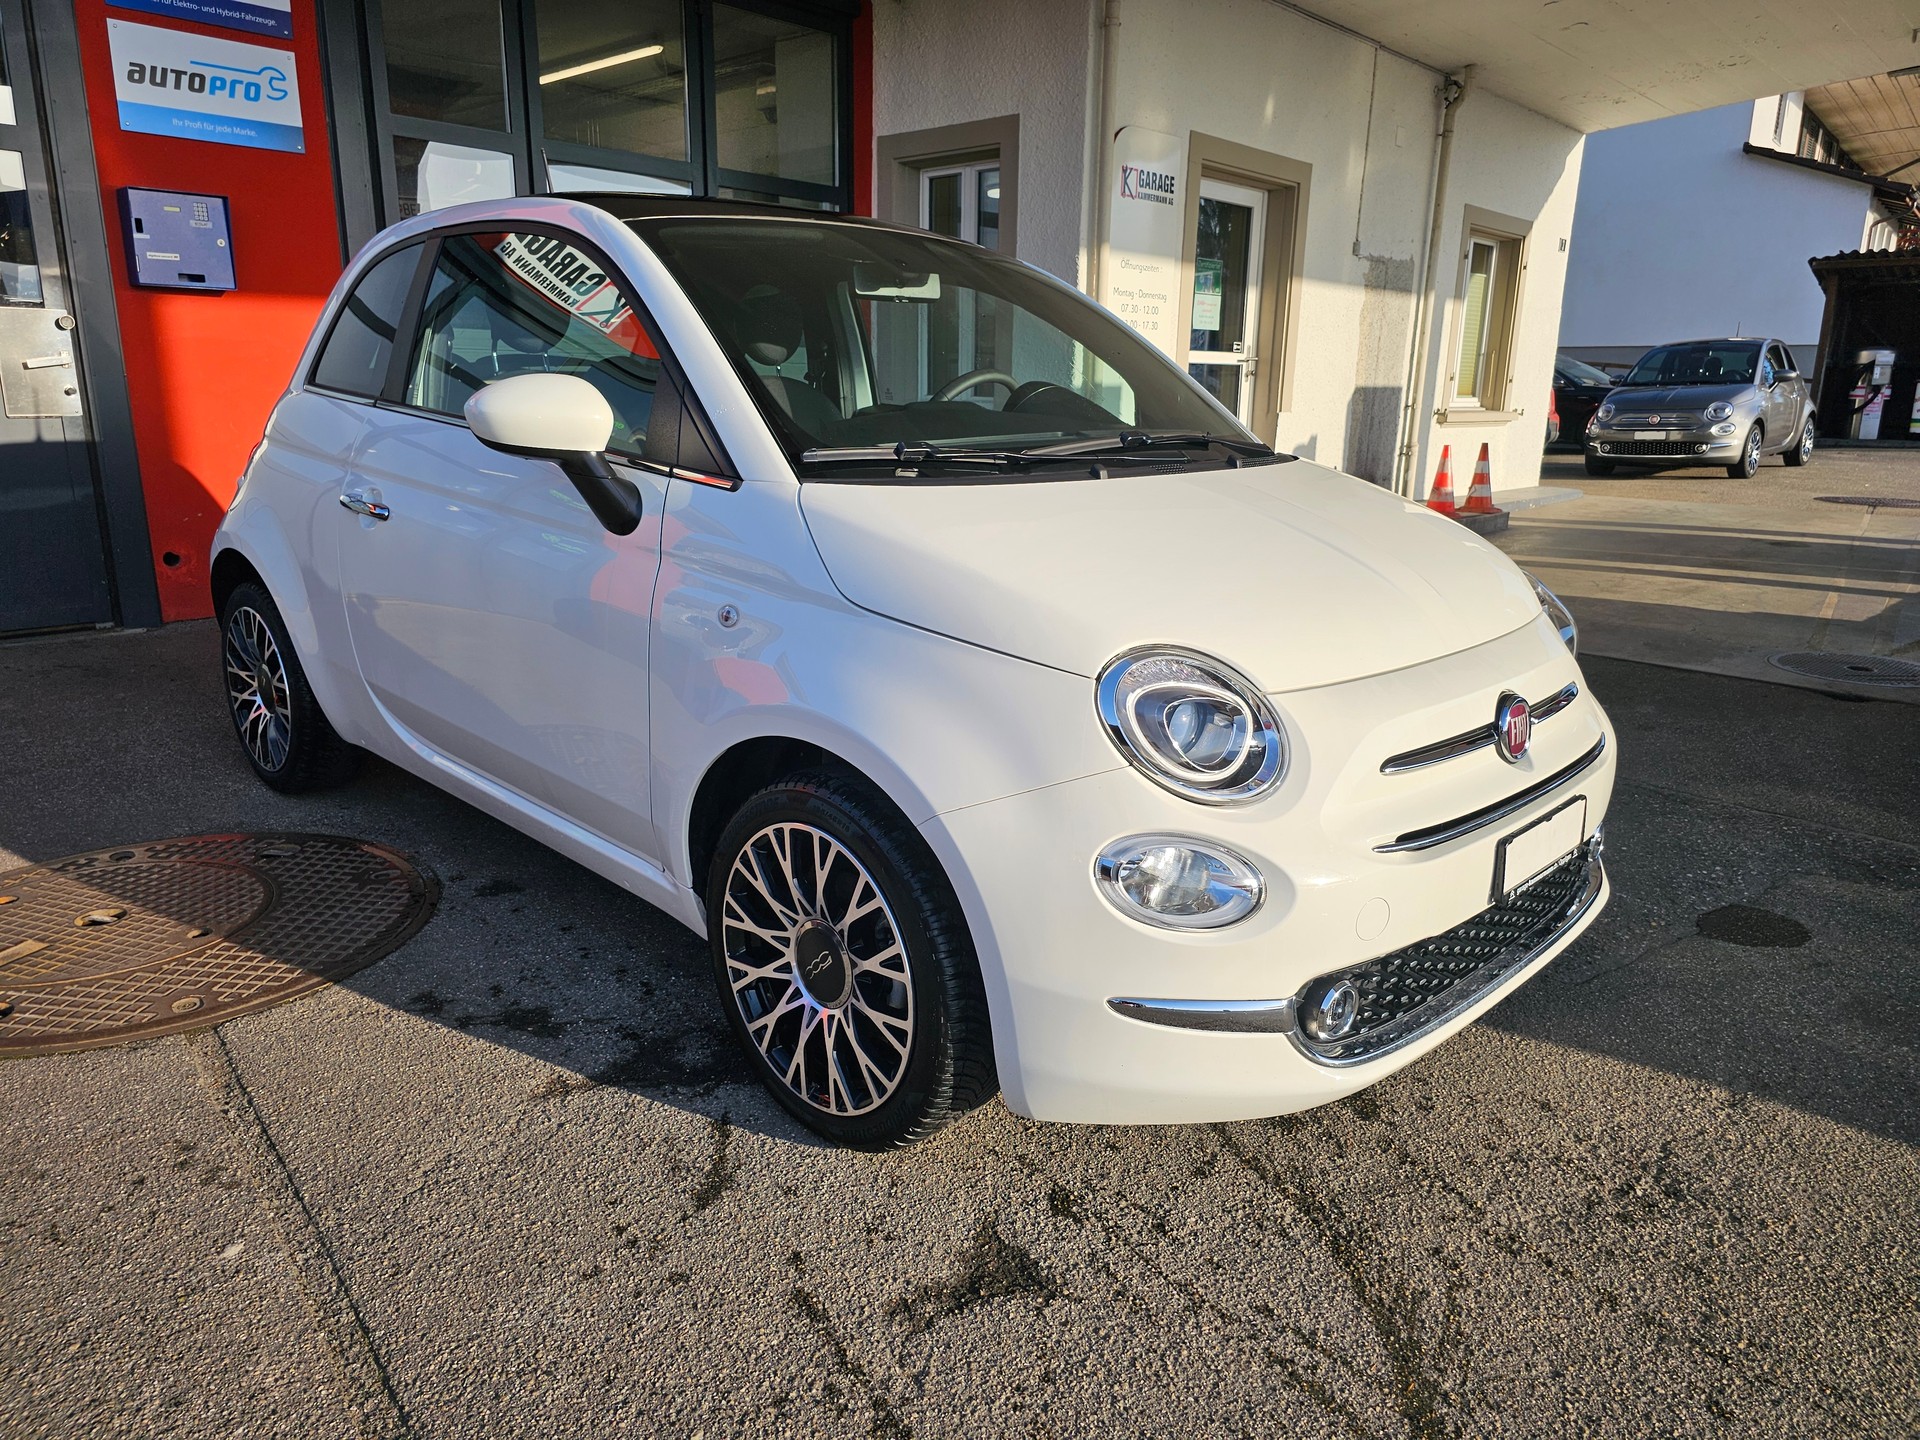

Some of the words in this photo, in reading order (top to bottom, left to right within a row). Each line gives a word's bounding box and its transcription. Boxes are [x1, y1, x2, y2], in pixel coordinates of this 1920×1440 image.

[201, 4, 215, 14] und
[216, 8, 278, 27] Hybrid-Fahrzeuge.
[172, 118, 183, 127] Ihr
[184, 119, 203, 129] Profi
[203, 122, 214, 131] für
[215, 124, 232, 134] jede
[233, 126, 258, 137] Marke.
[1138, 169, 1175, 194] GARAGE
[1120, 257, 1160, 274] Öffnungszeiten
[1113, 286, 1135, 300] Montag
[1138, 288, 1167, 303] Donnerstag
[1120, 303, 1139, 314] 07.30
[1143, 305, 1159, 315] 12.00
[1142, 321, 1159, 331] 17.30
[1510, 714, 1527, 746] FIAT
